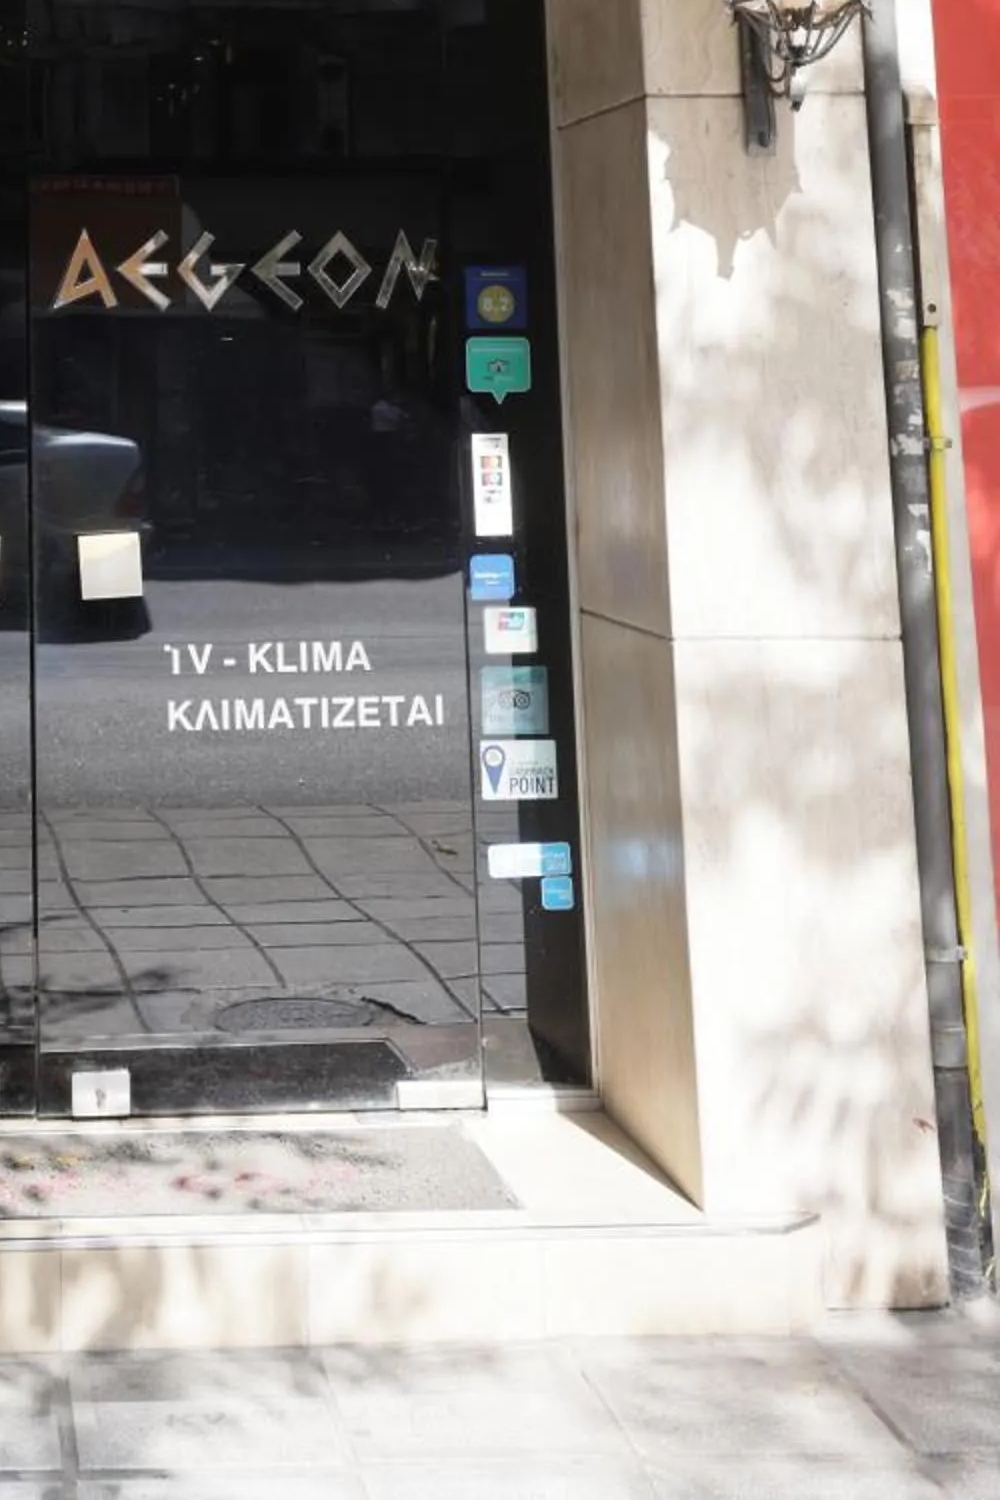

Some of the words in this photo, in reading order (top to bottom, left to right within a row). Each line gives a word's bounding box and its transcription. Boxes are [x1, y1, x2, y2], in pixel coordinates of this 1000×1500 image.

[53, 228, 439, 310] AEGEON
[247, 640, 372, 674] KLIMA
[510, 777, 555, 794] POINT
